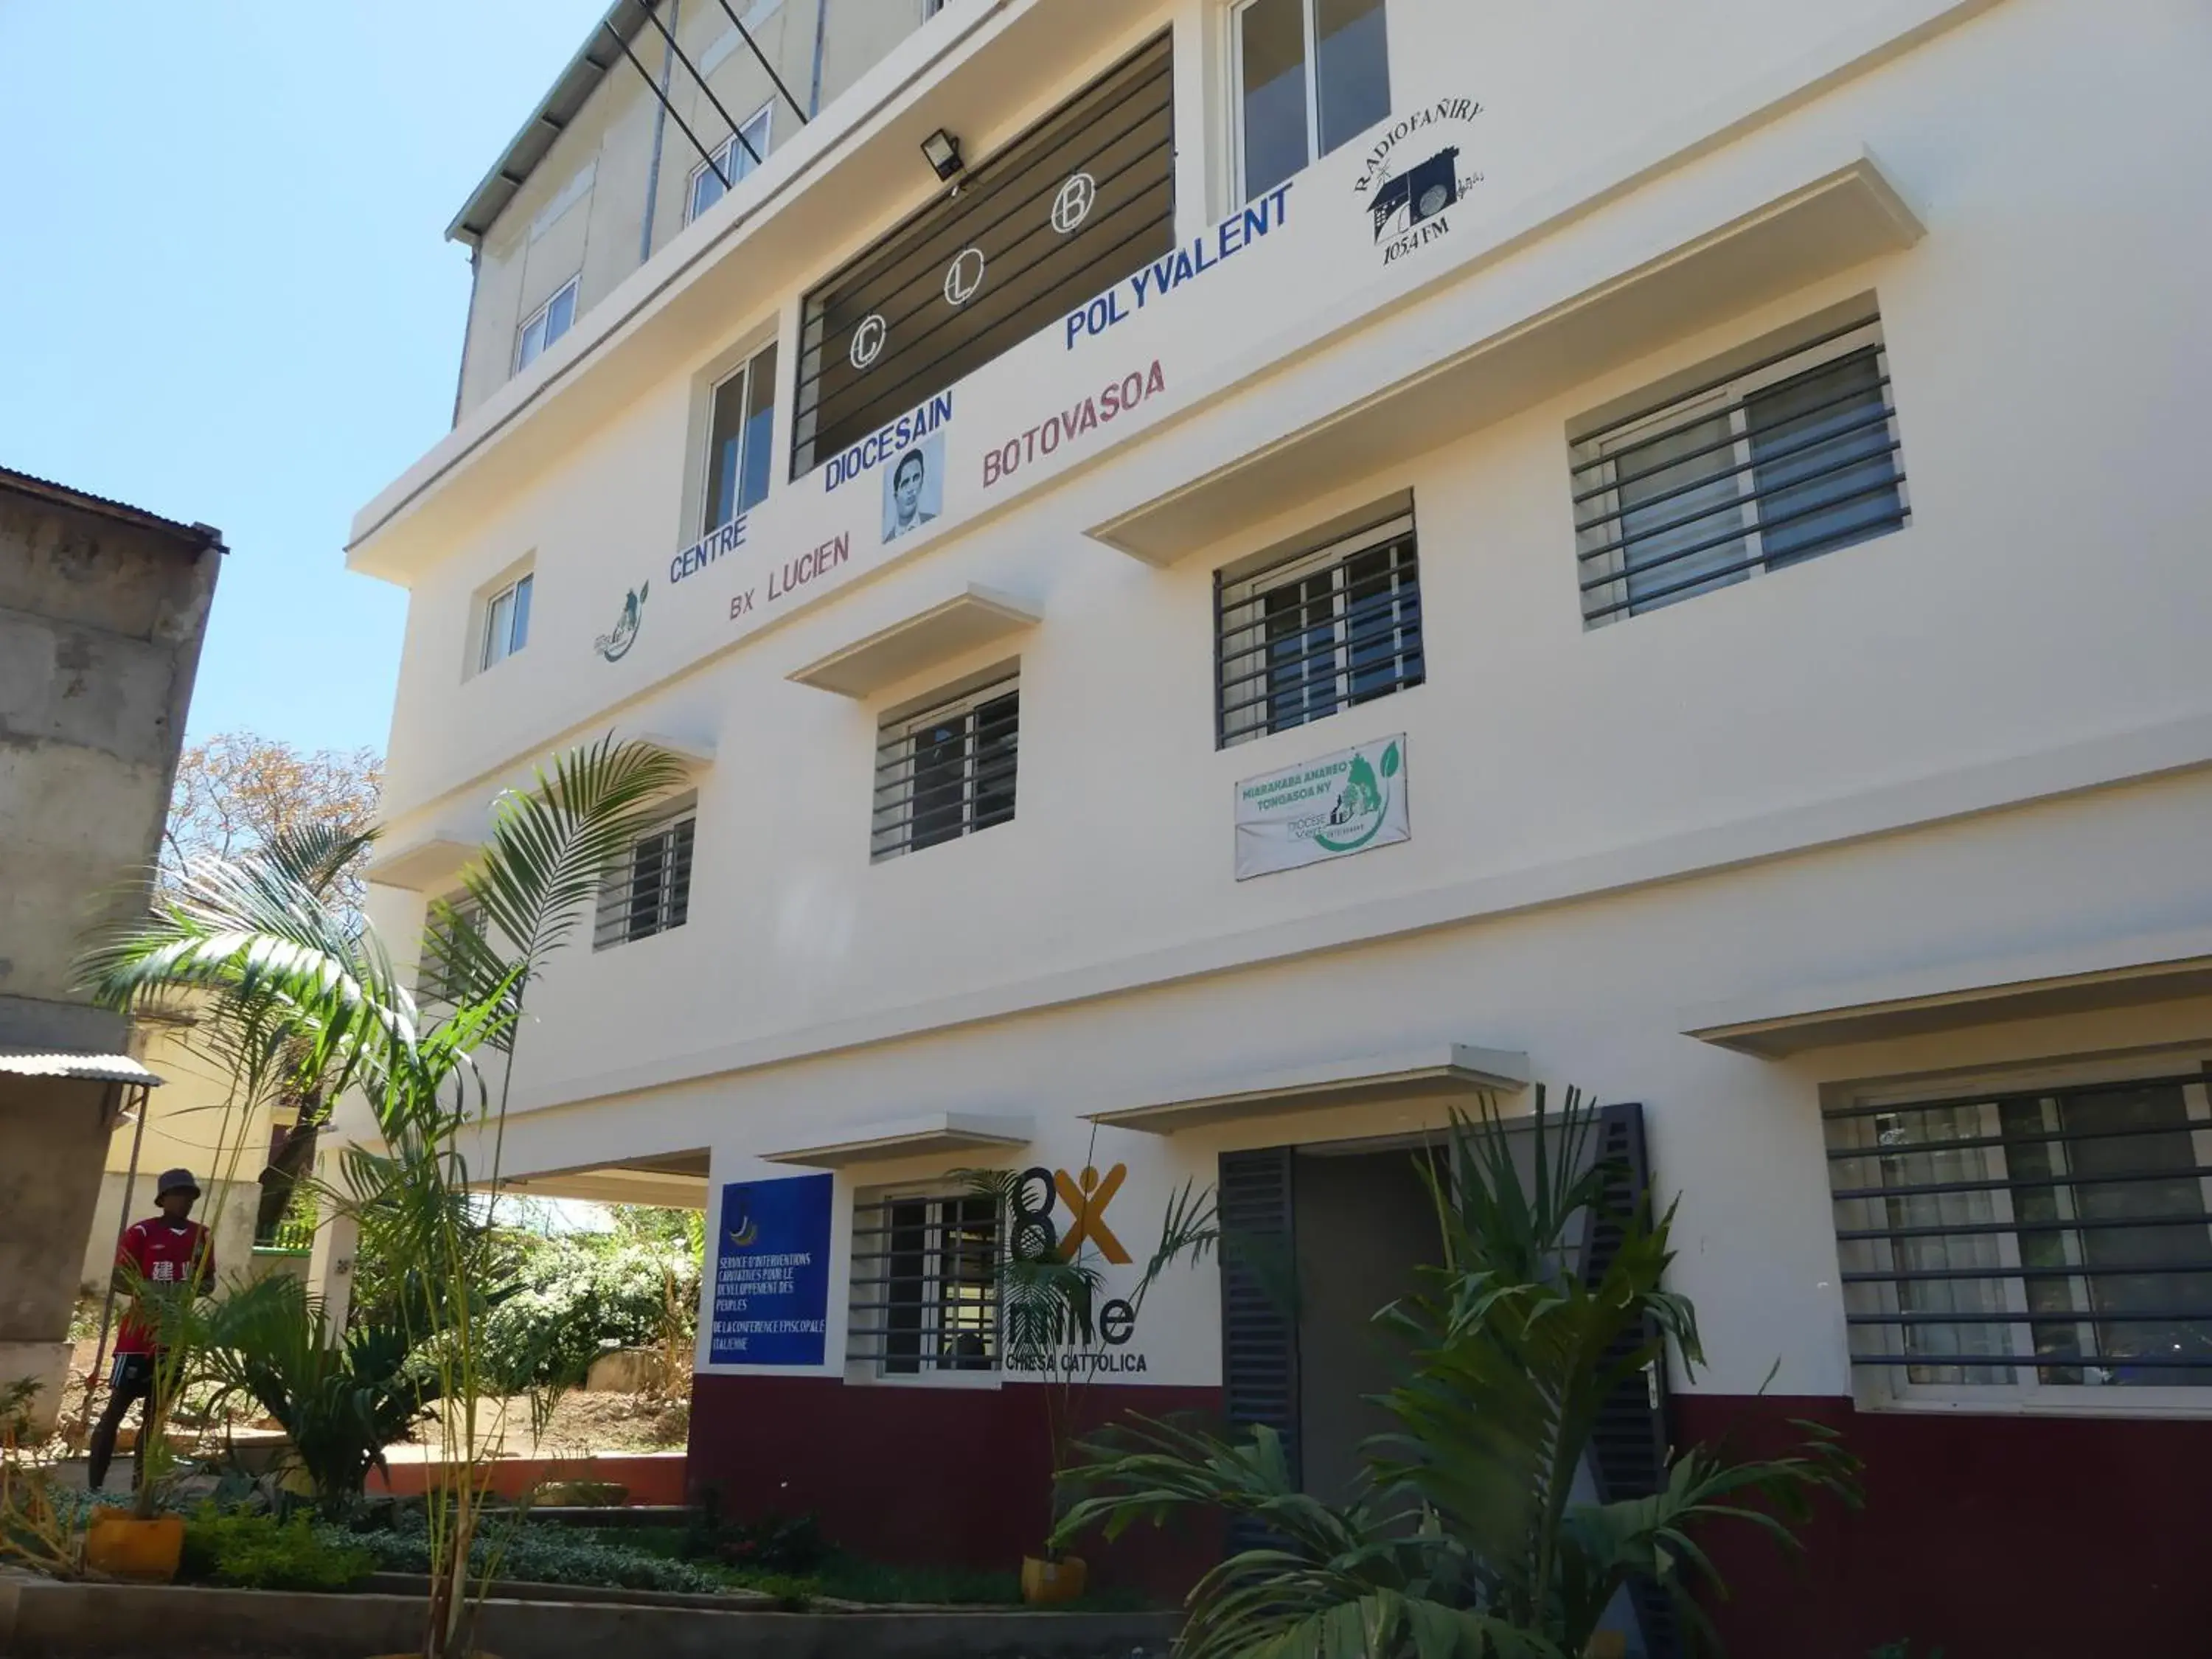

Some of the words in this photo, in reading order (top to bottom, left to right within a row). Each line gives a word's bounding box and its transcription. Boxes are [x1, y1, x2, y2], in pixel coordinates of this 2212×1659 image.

[1421, 216, 1450, 245] FM
[669, 515, 748, 584] CENTRE
[825, 391, 952, 493] DIOCESAIN
[1066, 182, 1294, 350] POLYVALENT
[729, 588, 755, 621] BX
[768, 530, 850, 602] LUCIEN
[982, 358, 1166, 490] BOTOVASOA
[1242, 774, 1301, 801] MIARAHABA
[1316, 779, 1332, 793] NY
[719, 1256, 747, 1269] SERVICE
[718, 1269, 762, 1282] CARITATIVES
[762, 1268, 782, 1281] POUR
[783, 1267, 794, 1280] LE
[778, 1281, 794, 1294] DES
[713, 1321, 723, 1333] DE
[723, 1321, 732, 1333] LA
[1060, 1353, 1147, 1373] CATTOLICA
